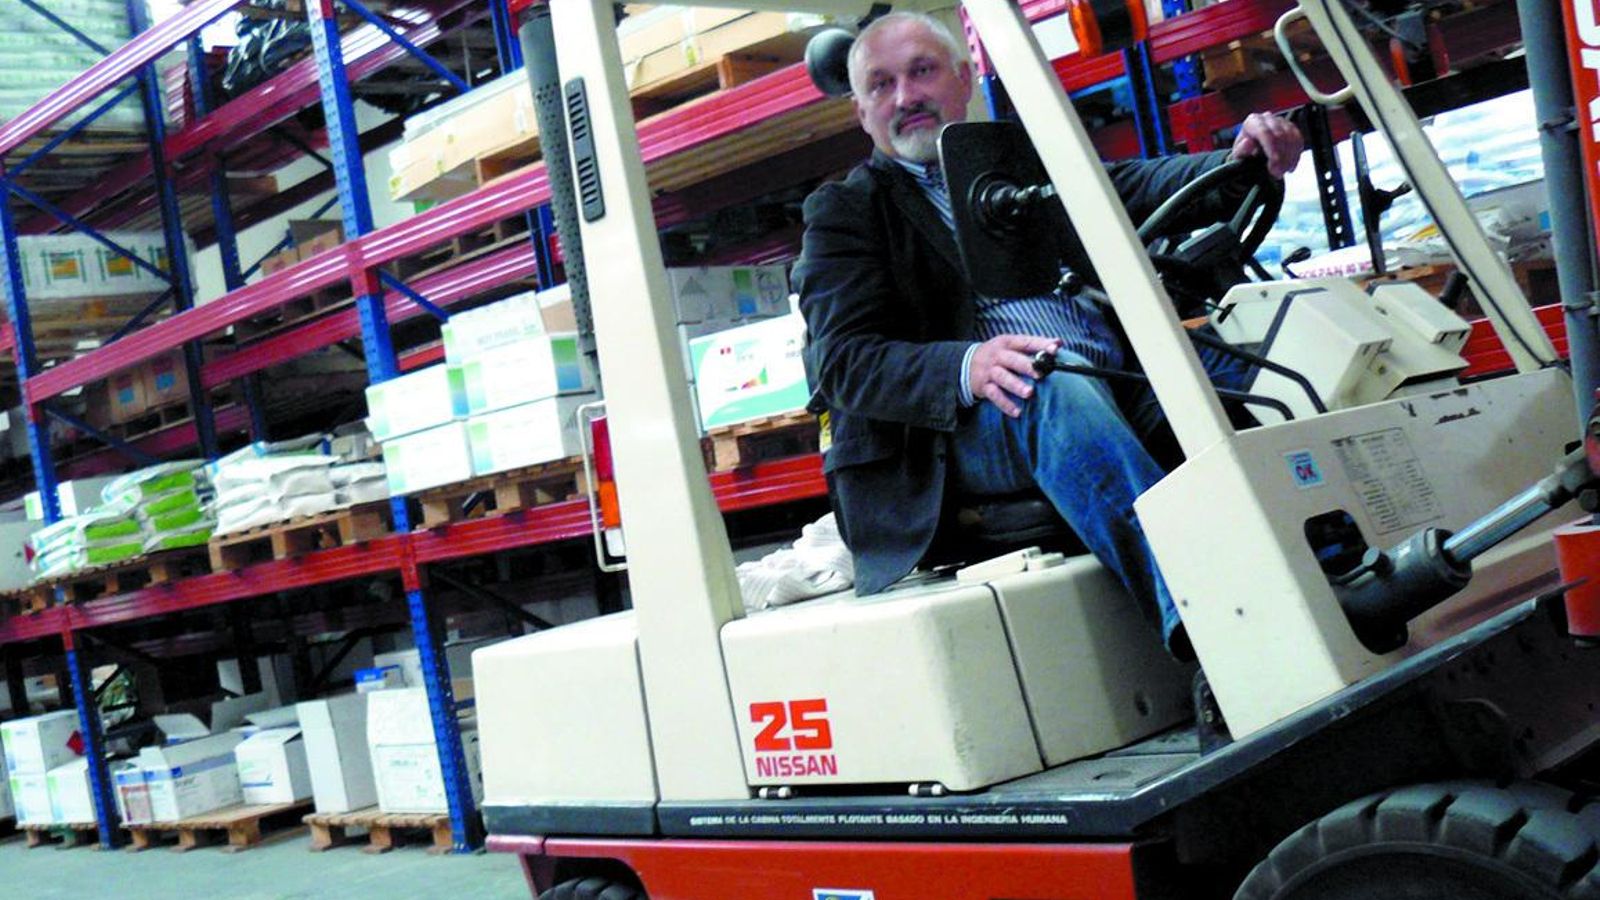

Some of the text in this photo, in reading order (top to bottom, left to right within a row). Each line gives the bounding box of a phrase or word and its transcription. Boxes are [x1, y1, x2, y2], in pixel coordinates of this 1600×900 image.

[750, 698, 832, 752] 25
[756, 754, 838, 778] NISSAN
[690, 816, 723, 826] SISTEMA
[725, 815, 737, 825] DE
[738, 815, 750, 825] LA
[751, 815, 780, 824] CABINA
[781, 814, 836, 824] TOTALMENTE
[837, 814, 884, 824] FLOTANTE
[885, 814, 925, 824] BASADO
[927, 814, 942, 824] EN
[943, 814, 959, 824] LA
[1020, 814, 1068, 824] HUMANA
